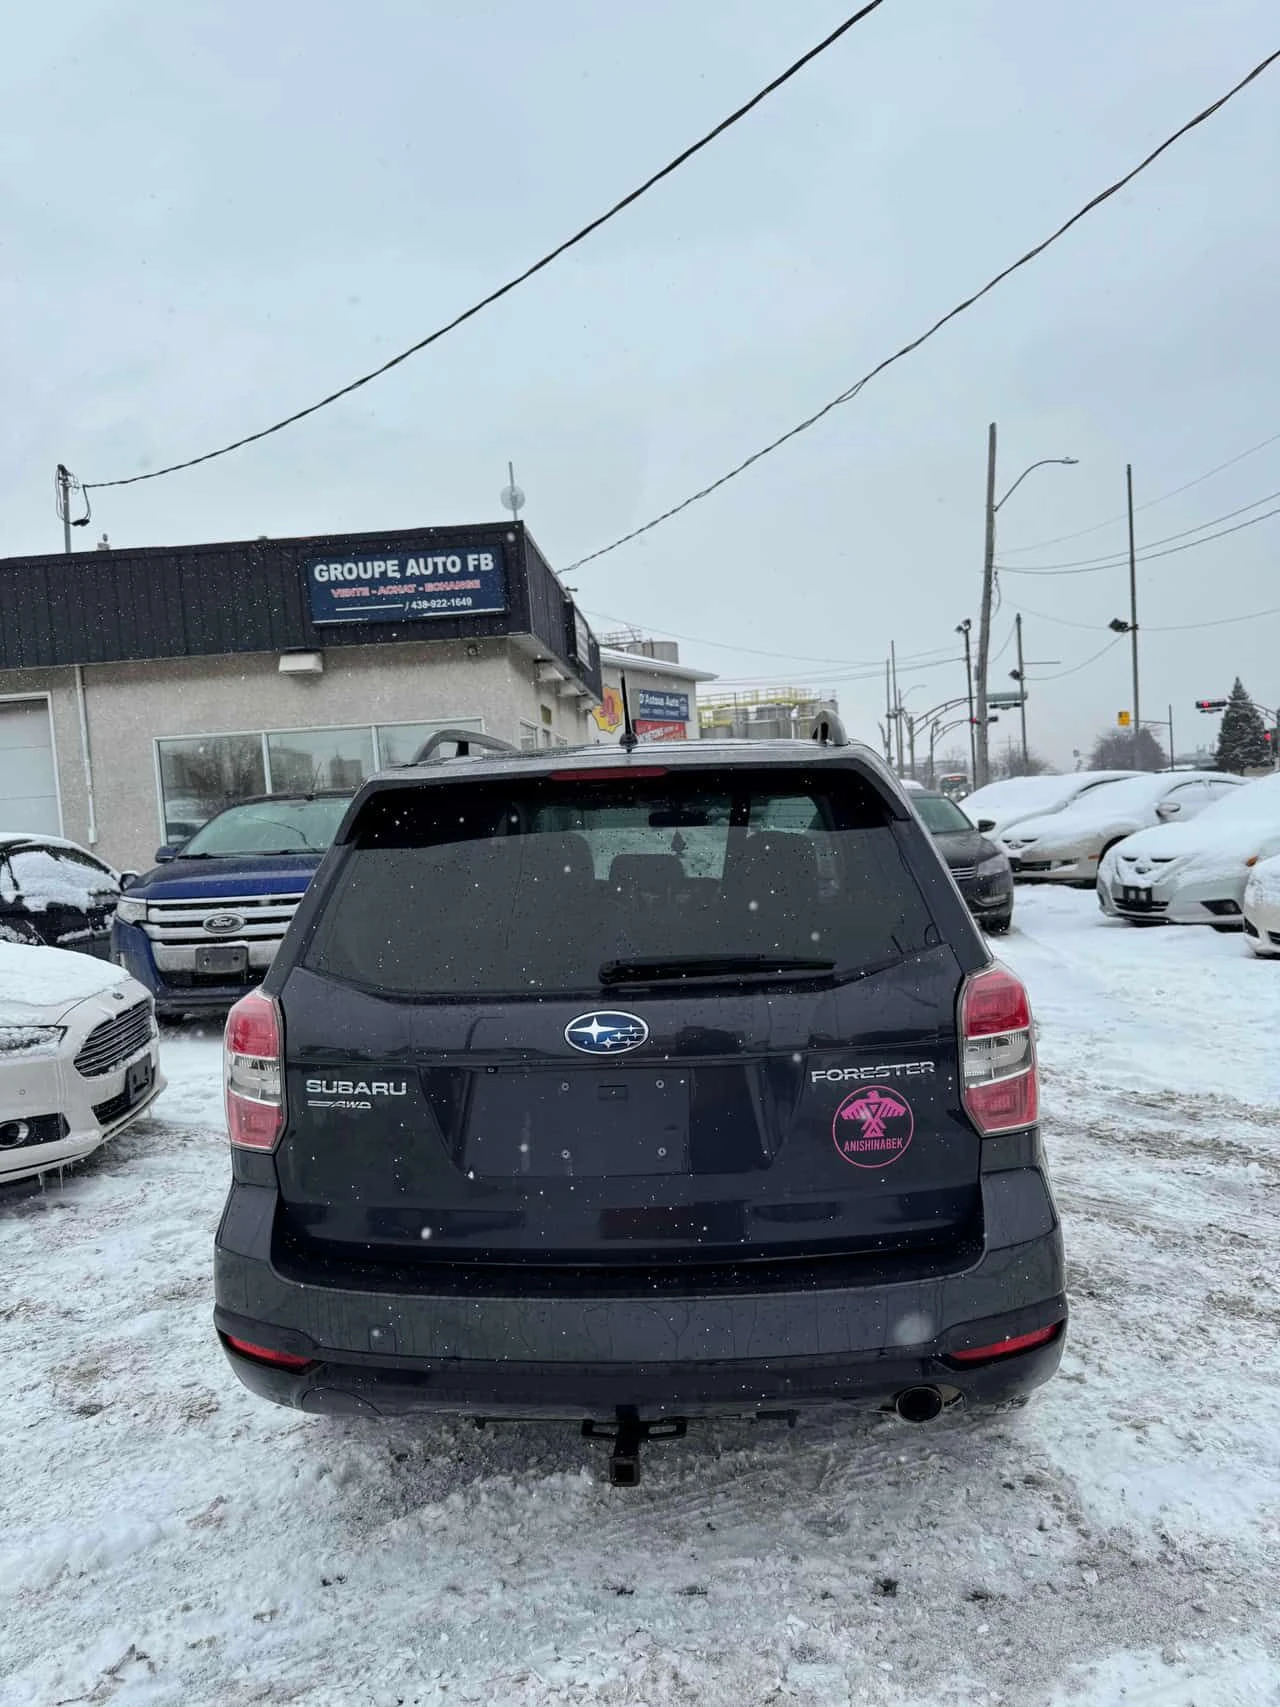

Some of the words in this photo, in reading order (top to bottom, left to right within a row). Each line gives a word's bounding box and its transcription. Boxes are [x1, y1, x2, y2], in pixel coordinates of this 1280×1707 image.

[314, 560, 400, 582] GROUPE
[405, 556, 462, 577] AUTO
[467, 553, 494, 572] FB
[811, 1061, 936, 1082] FORESTER
[306, 1079, 407, 1095] SUBARU
[844, 1137, 904, 1152] ANISHINABEK
